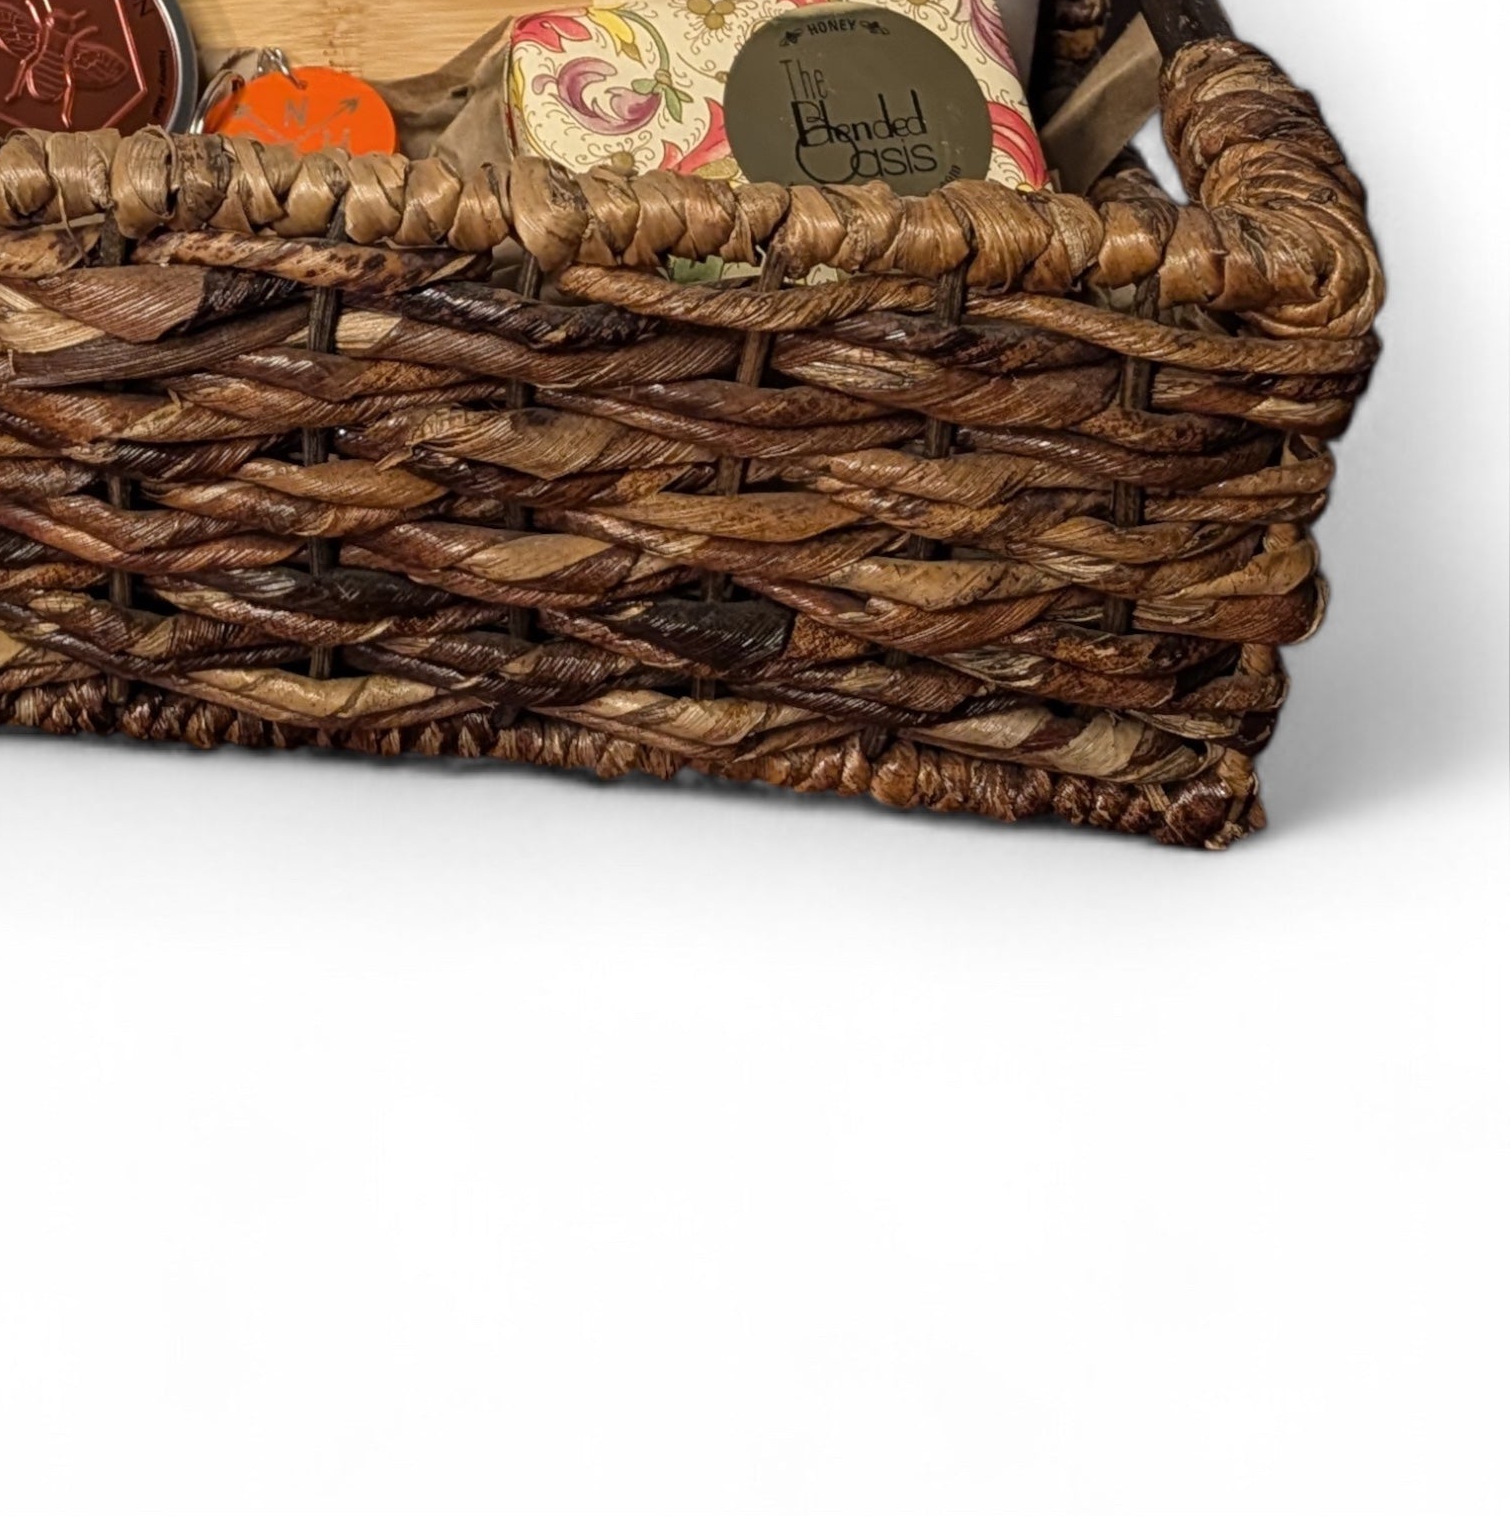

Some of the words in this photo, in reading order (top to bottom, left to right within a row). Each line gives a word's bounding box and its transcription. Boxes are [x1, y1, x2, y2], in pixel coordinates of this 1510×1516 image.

[806, 17, 858, 36] HONEY
[779, 59, 829, 101] The
[791, 89, 928, 148] Blended
[795, 125, 938, 185] Oasis
